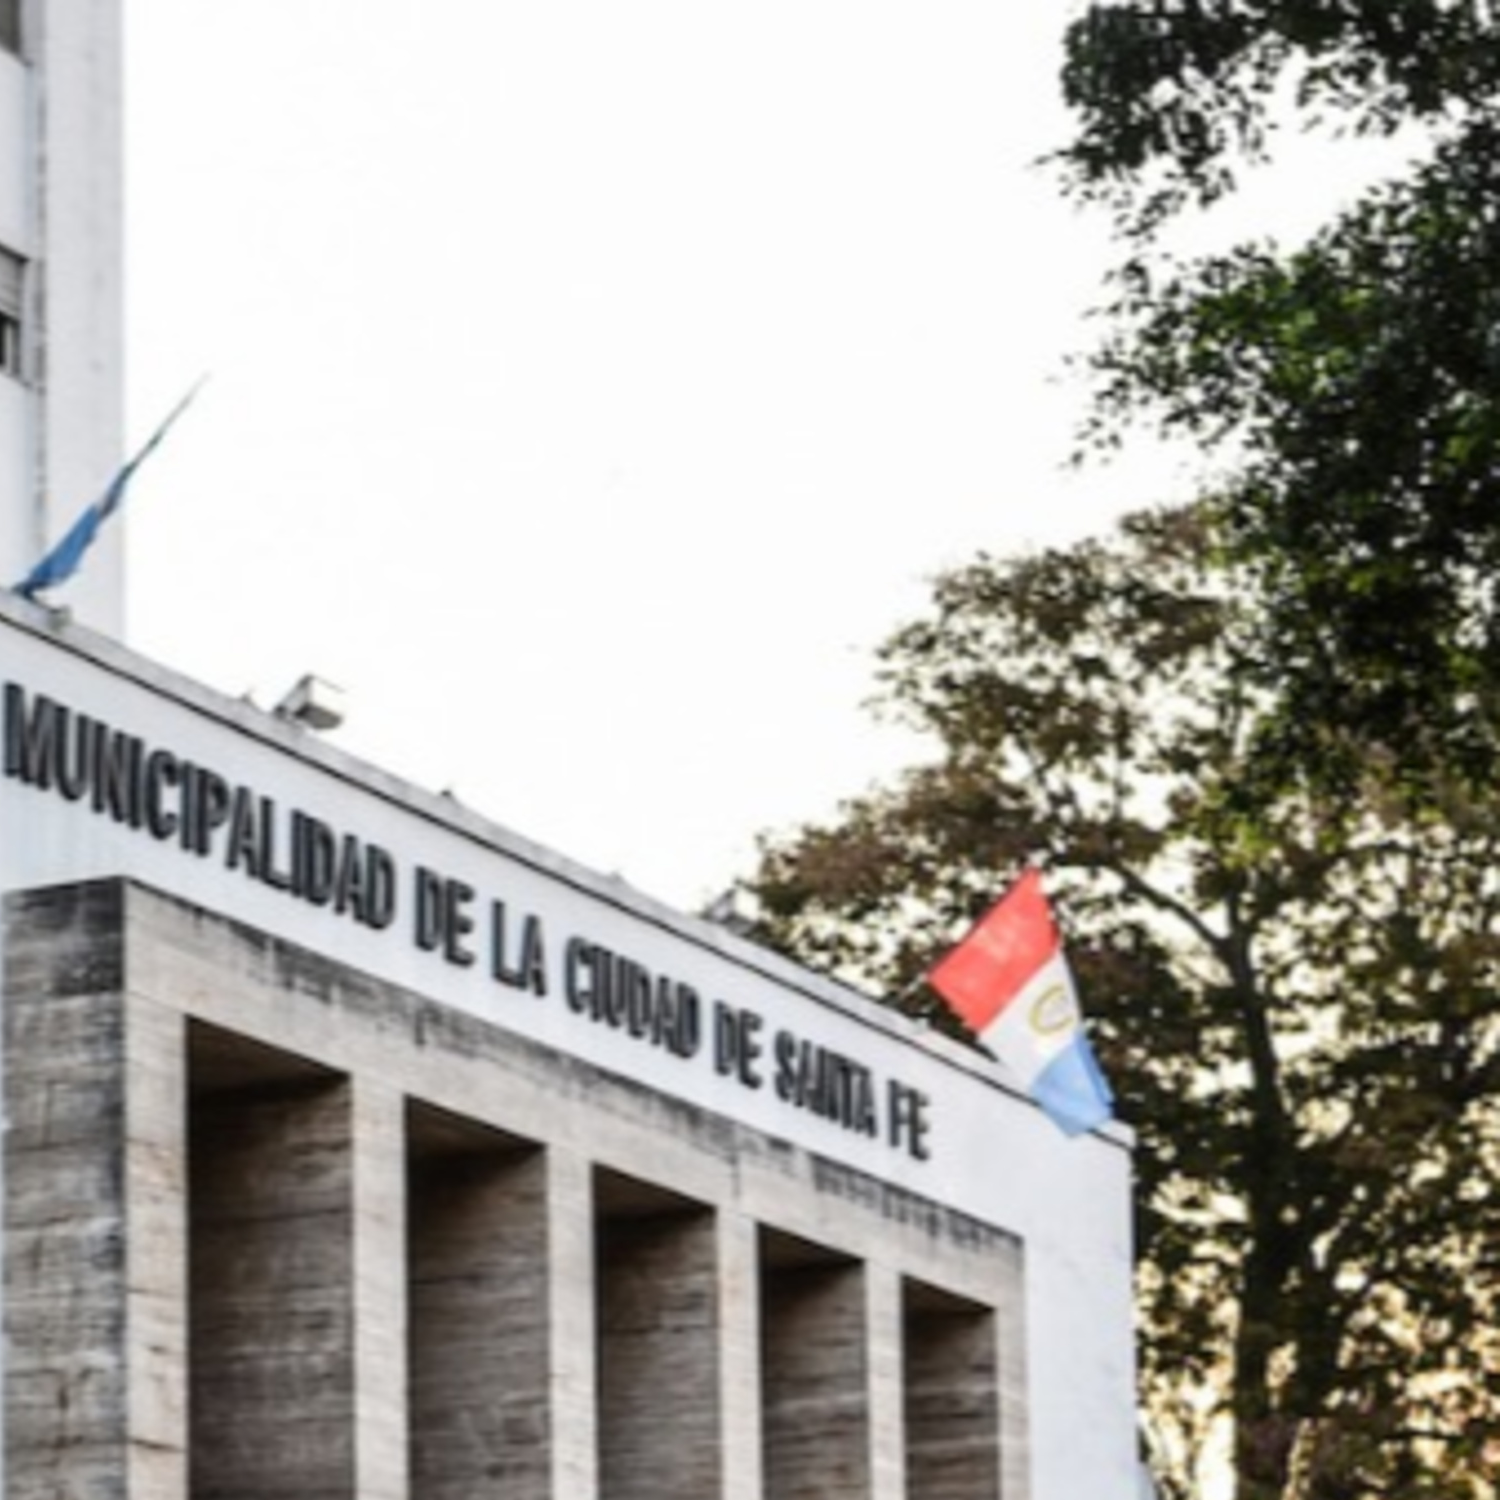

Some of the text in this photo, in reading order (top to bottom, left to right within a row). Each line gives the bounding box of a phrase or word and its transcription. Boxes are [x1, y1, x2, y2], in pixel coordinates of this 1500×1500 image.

[3, 681, 931, 1162] MUNICIPALIDAD DE LA CIUDAD DE SANTA FE
